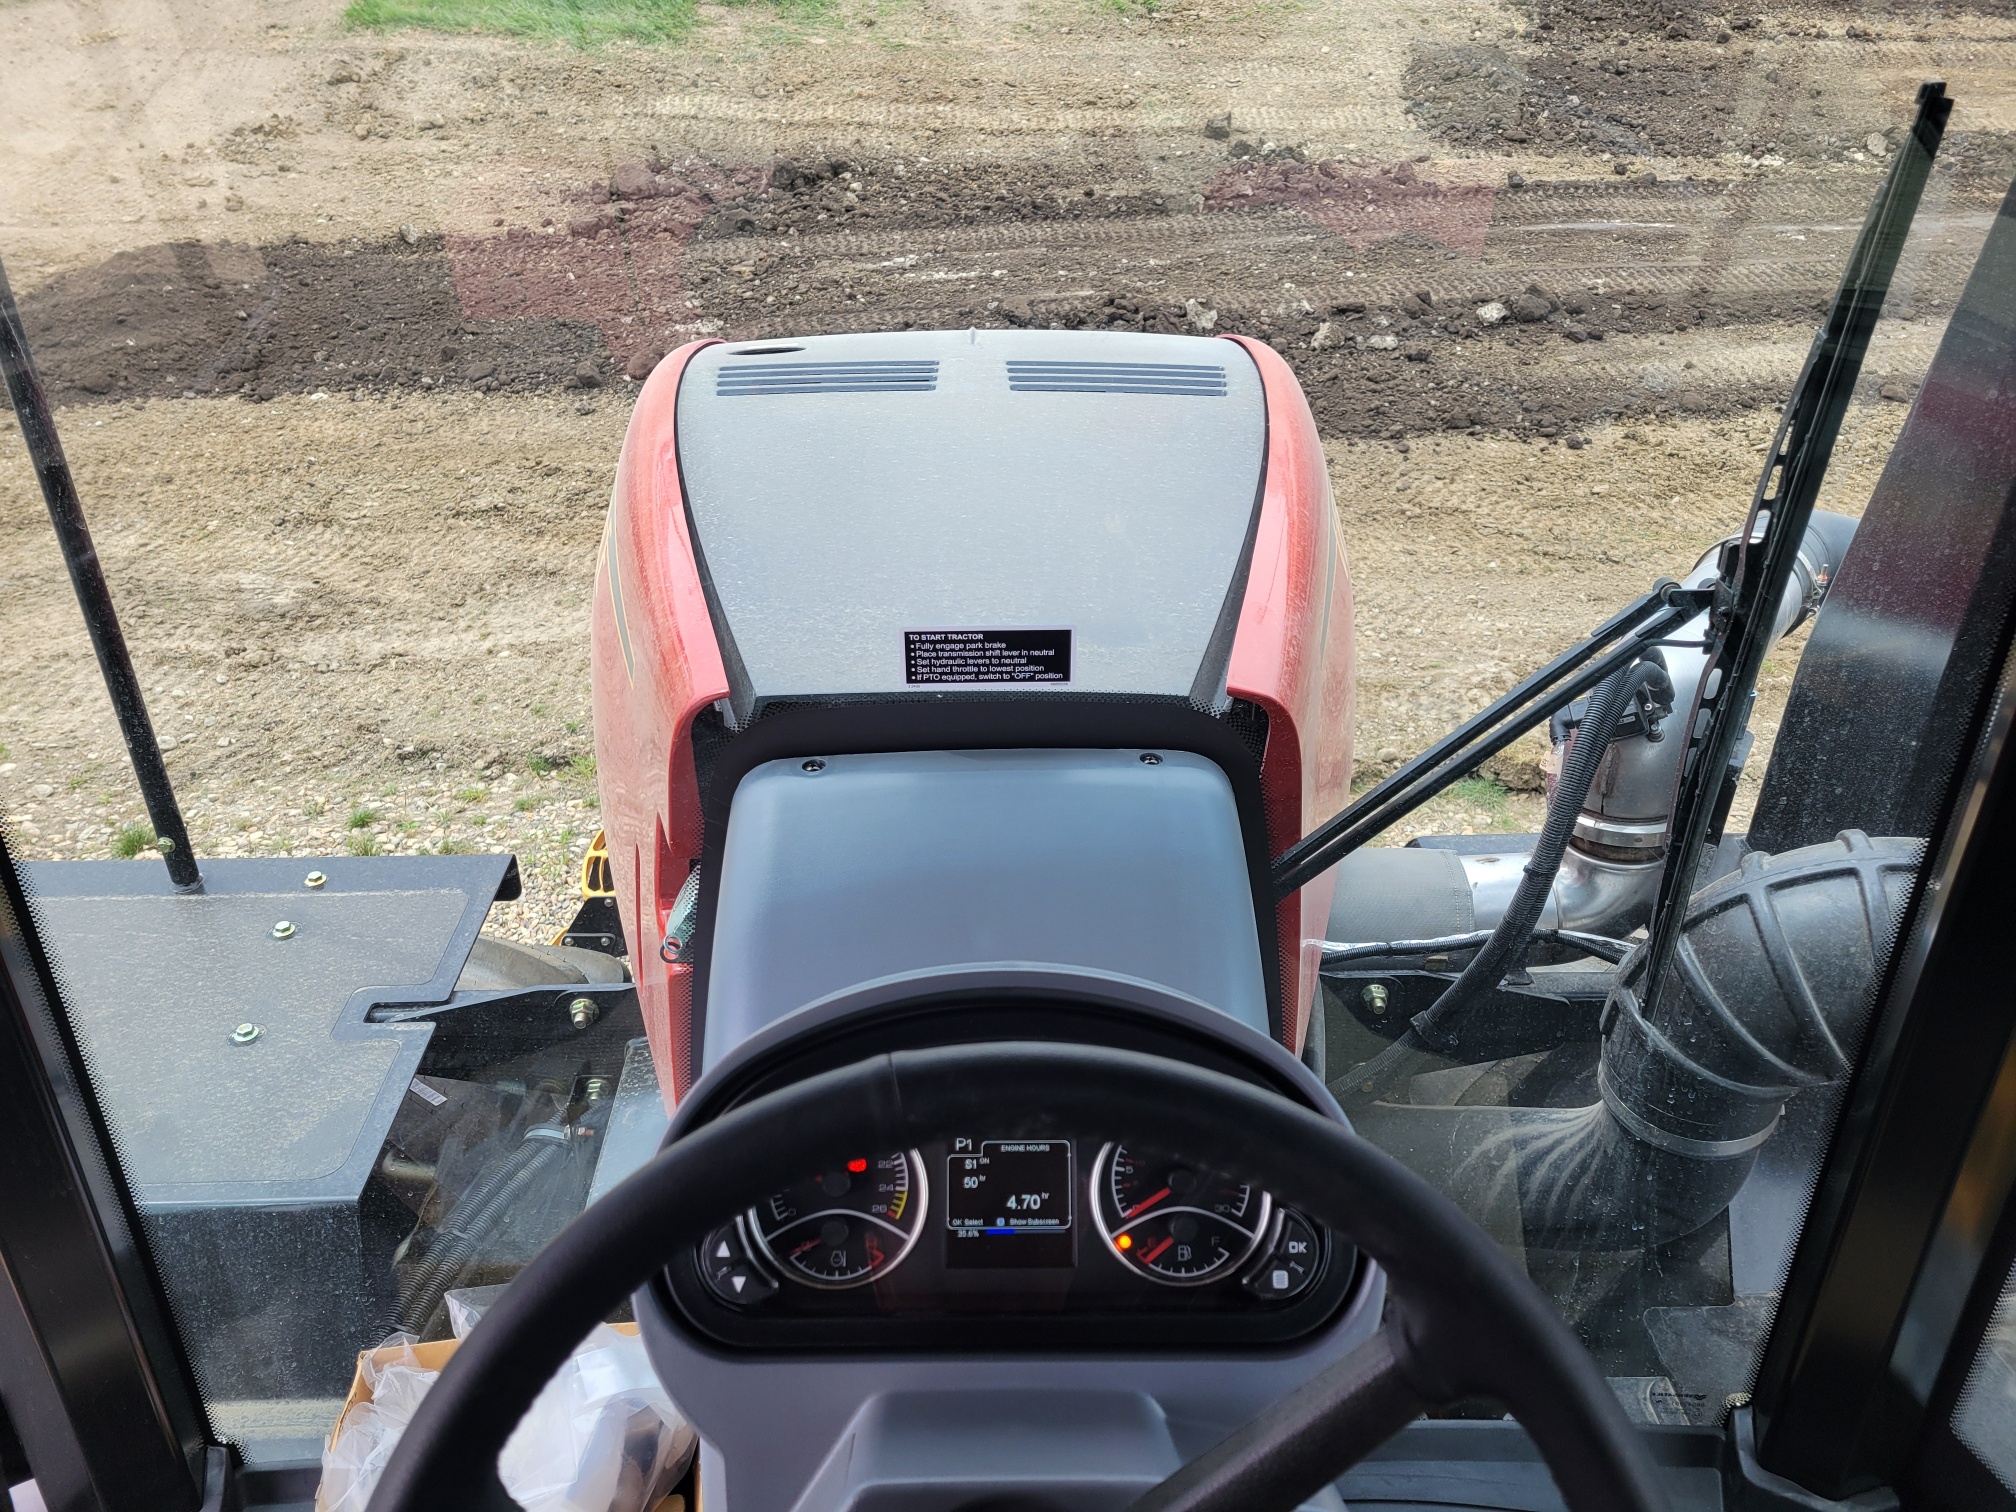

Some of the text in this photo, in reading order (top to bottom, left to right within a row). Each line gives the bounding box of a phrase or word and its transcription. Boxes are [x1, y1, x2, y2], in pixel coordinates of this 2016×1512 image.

[915, 641, 1007, 651] Fully engage park brake
[916, 650, 937, 658] Place
[985, 649, 1001, 657] shift
[1029, 648, 1055, 656] neutral
[916, 658, 930, 666] Set
[931, 658, 966, 667] hydraulic
[991, 657, 1000, 665] to
[1000, 656, 1027, 664] neutral
[952, 665, 979, 673] throttle
[1015, 665, 1045, 673] position
[941, 674, 978, 682] equipped,
[1035, 672, 1063, 681] position
[955, 1137, 972, 1151] P1
[1000, 1144, 1050, 1152] ENGINE HOURS
[878, 1159, 894, 1168] 22
[879, 1183, 894, 1192] 24
[1006, 1194, 1041, 1210] 4.70
[964, 1218, 984, 1226] Select
[1009, 1217, 1060, 1226] Show Subscreen
[1288, 1240, 1308, 1254] OK
